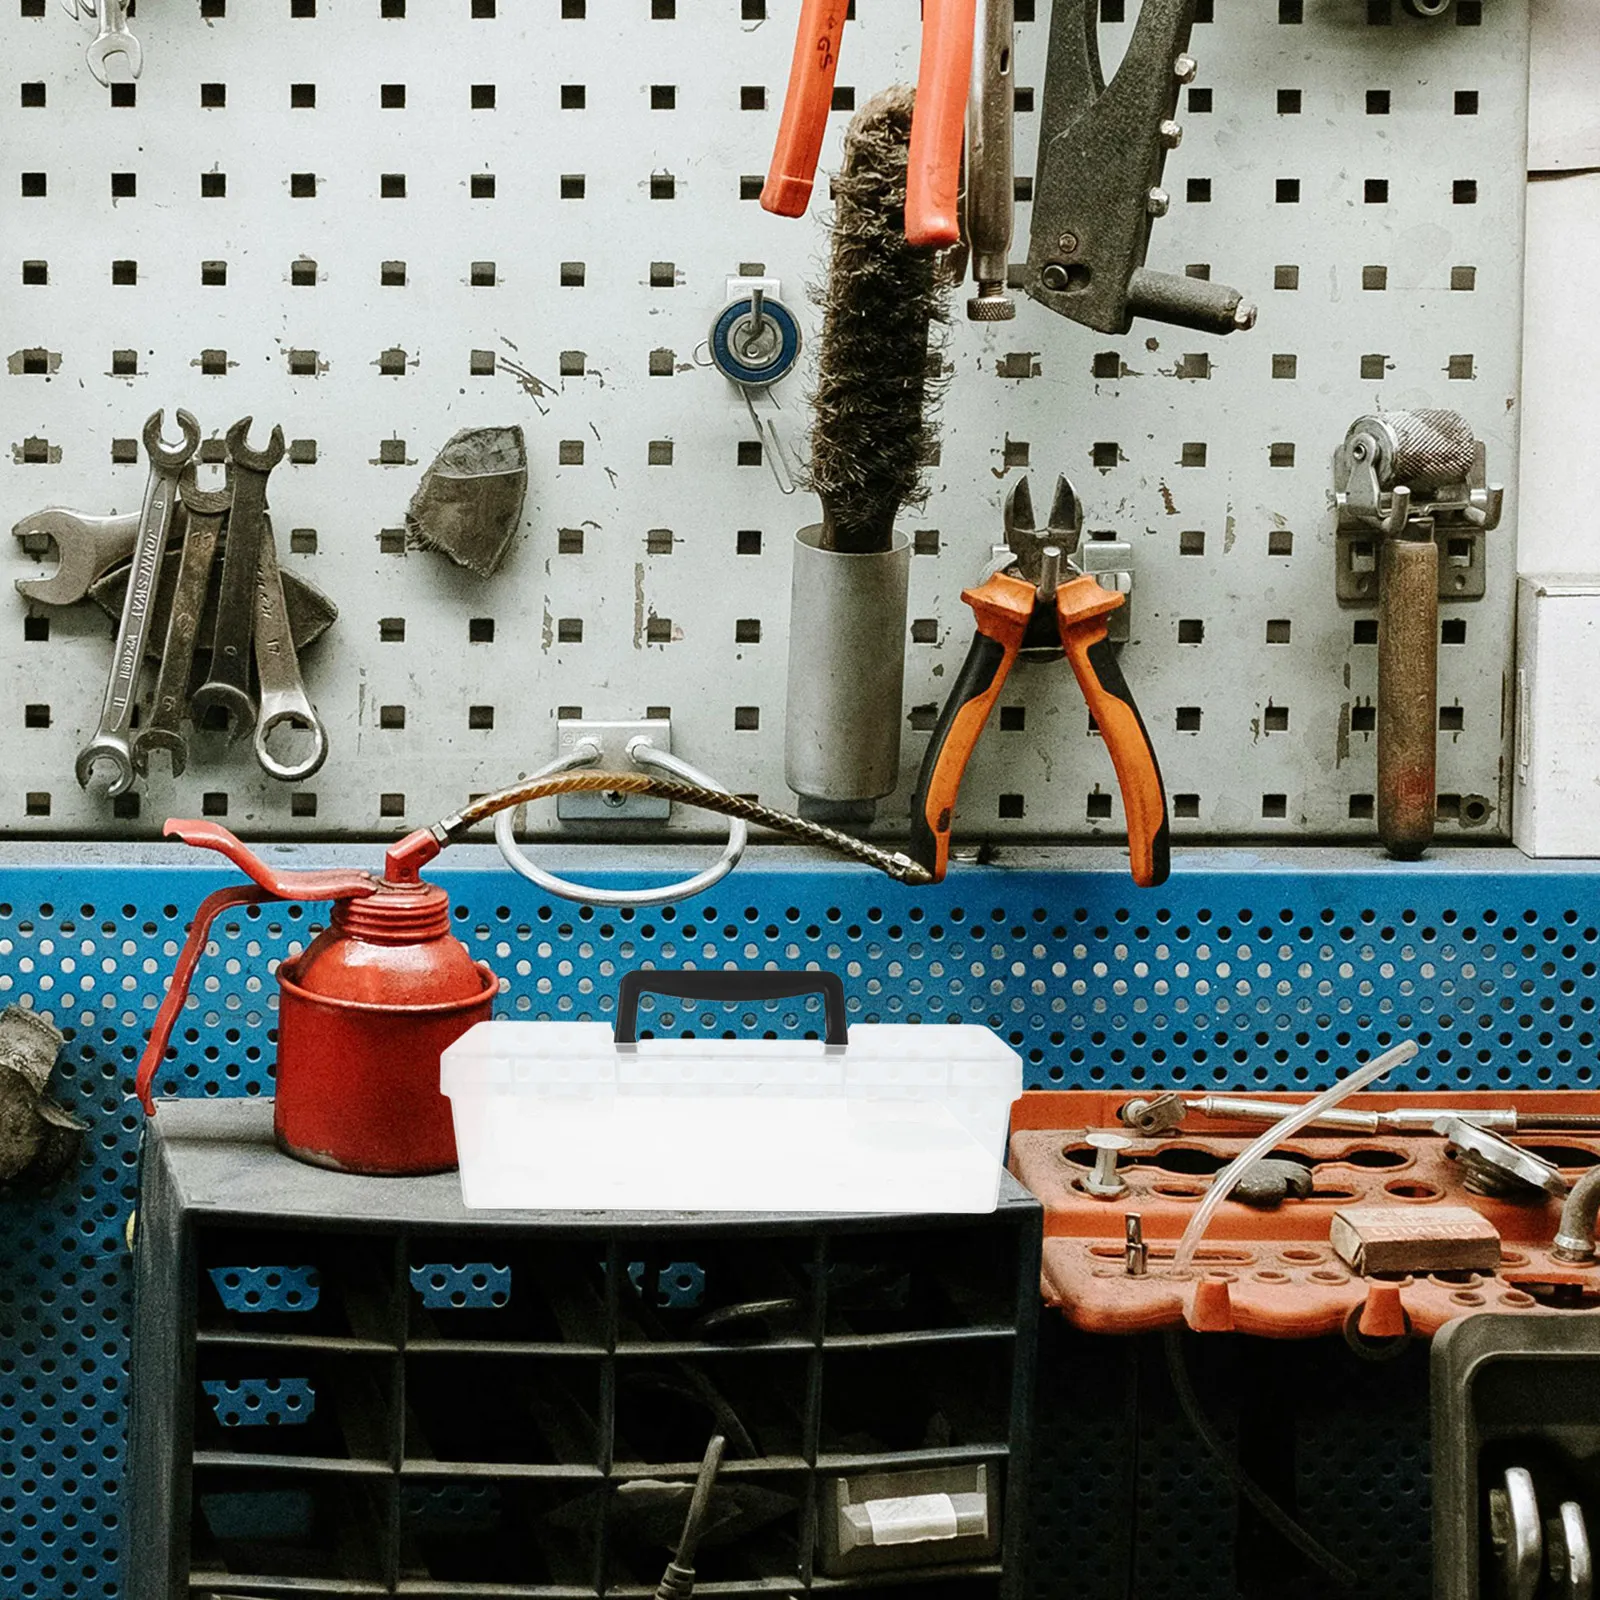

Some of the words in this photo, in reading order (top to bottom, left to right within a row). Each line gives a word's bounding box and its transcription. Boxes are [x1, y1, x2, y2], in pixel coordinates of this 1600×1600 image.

[817, 36, 834, 71] GS
[131, 529, 158, 621] JONNESWAY
[1371, 1223, 1481, 1236] СПИЧКИ
